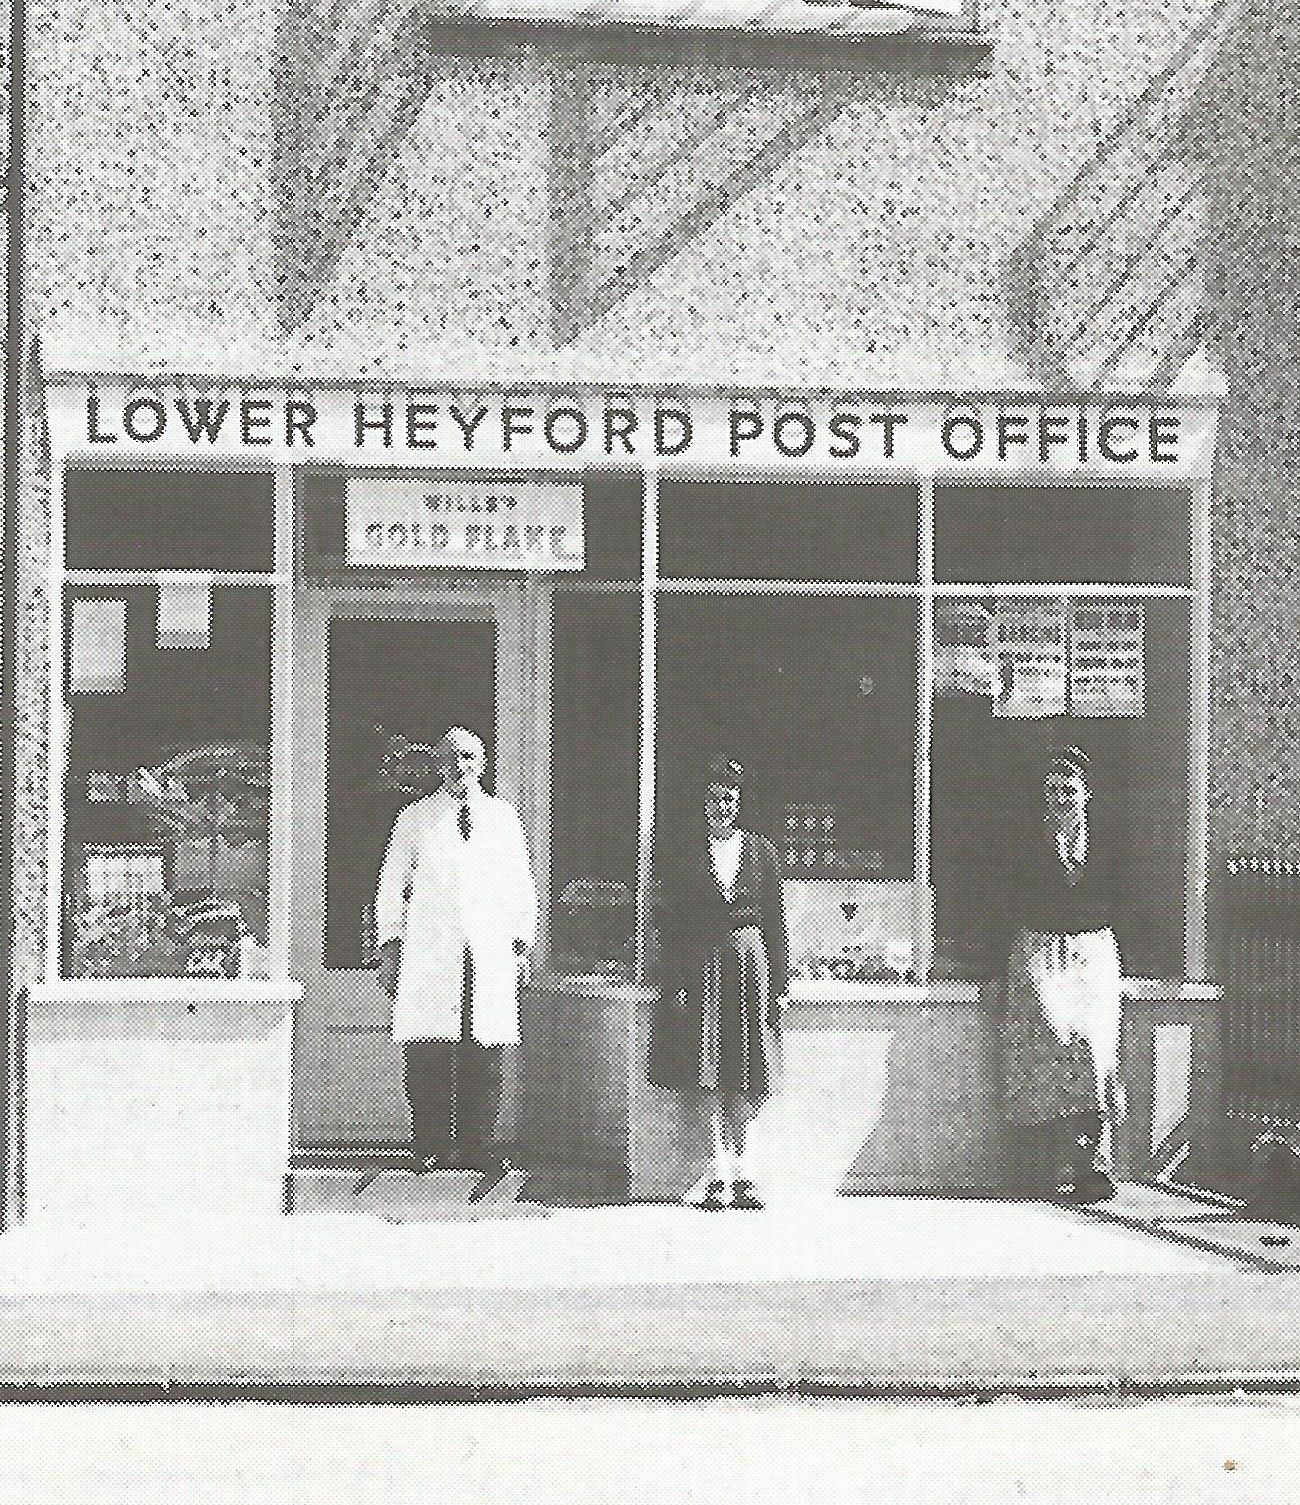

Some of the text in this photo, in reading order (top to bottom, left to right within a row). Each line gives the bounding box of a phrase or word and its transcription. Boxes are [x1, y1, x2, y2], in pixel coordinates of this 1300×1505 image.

[86, 395, 1179, 464] LOWER HEYFORD POST OFFICE
[365, 522, 580, 561] GOLD FLAKE
